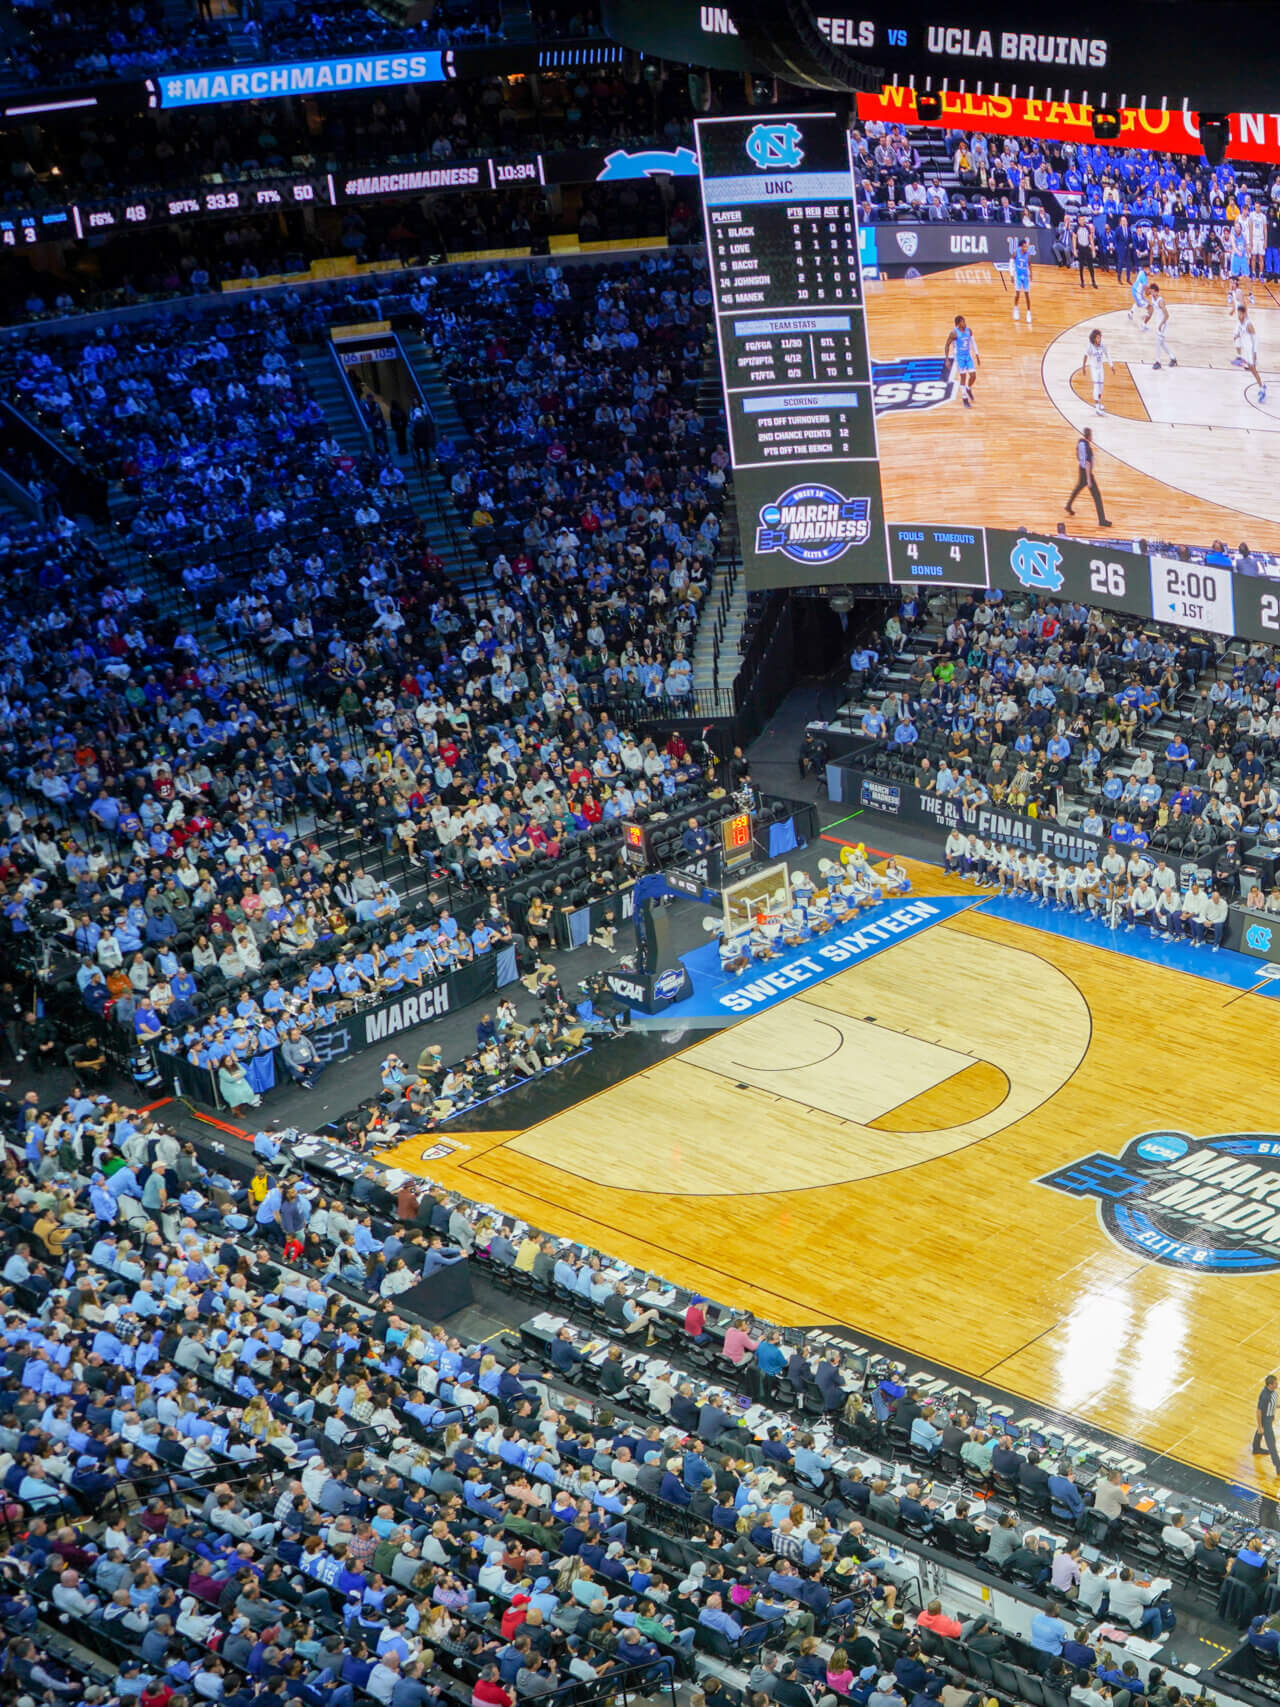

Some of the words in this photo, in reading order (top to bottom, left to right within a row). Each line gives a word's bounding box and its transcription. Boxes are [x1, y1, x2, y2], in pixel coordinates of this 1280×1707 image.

[928, 26, 993, 57] UCLA
[1000, 32, 1107, 67] BRUINS
[167, 56, 427, 100] #MARCHMADNESS
[345, 167, 480, 195] #MARCHMADNESS
[497, 164, 536, 181] 10:34
[765, 180, 793, 195] UNC
[125, 205, 147, 222] 48
[206, 192, 240, 210] 33.3
[256, 190, 280, 204] FT%
[293, 184, 313, 200] 50
[3, 230, 15, 246] 4
[24, 227, 36, 243] 3
[728, 226, 755, 238] BLACK
[730, 243, 750, 254] LOVE
[950, 235, 988, 254] UCLA
[815, 256, 821, 266] 7
[770, 321, 792, 331] TEAM
[793, 320, 817, 330] STATS
[781, 504, 839, 524] MARCH
[790, 520, 867, 540] MADNESS
[899, 531, 924, 542] FOULS
[934, 533, 975, 544] TIMEOUTS
[907, 544, 918, 560] 4
[949, 546, 961, 562] 4
[911, 565, 943, 576] BONUS
[1089, 559, 1126, 597] 26
[1166, 568, 1217, 602] 2:00
[1182, 601, 1205, 620] 1ST
[920, 795, 943, 816] THE
[979, 811, 1036, 851] FINAL
[719, 956, 825, 1012] SWEET
[818, 900, 941, 963] SIXTEEN
[366, 982, 449, 1043] MARCH
[1140, 1141, 1179, 1161] NCAA
[1137, 1231, 1190, 1260] ELITE
